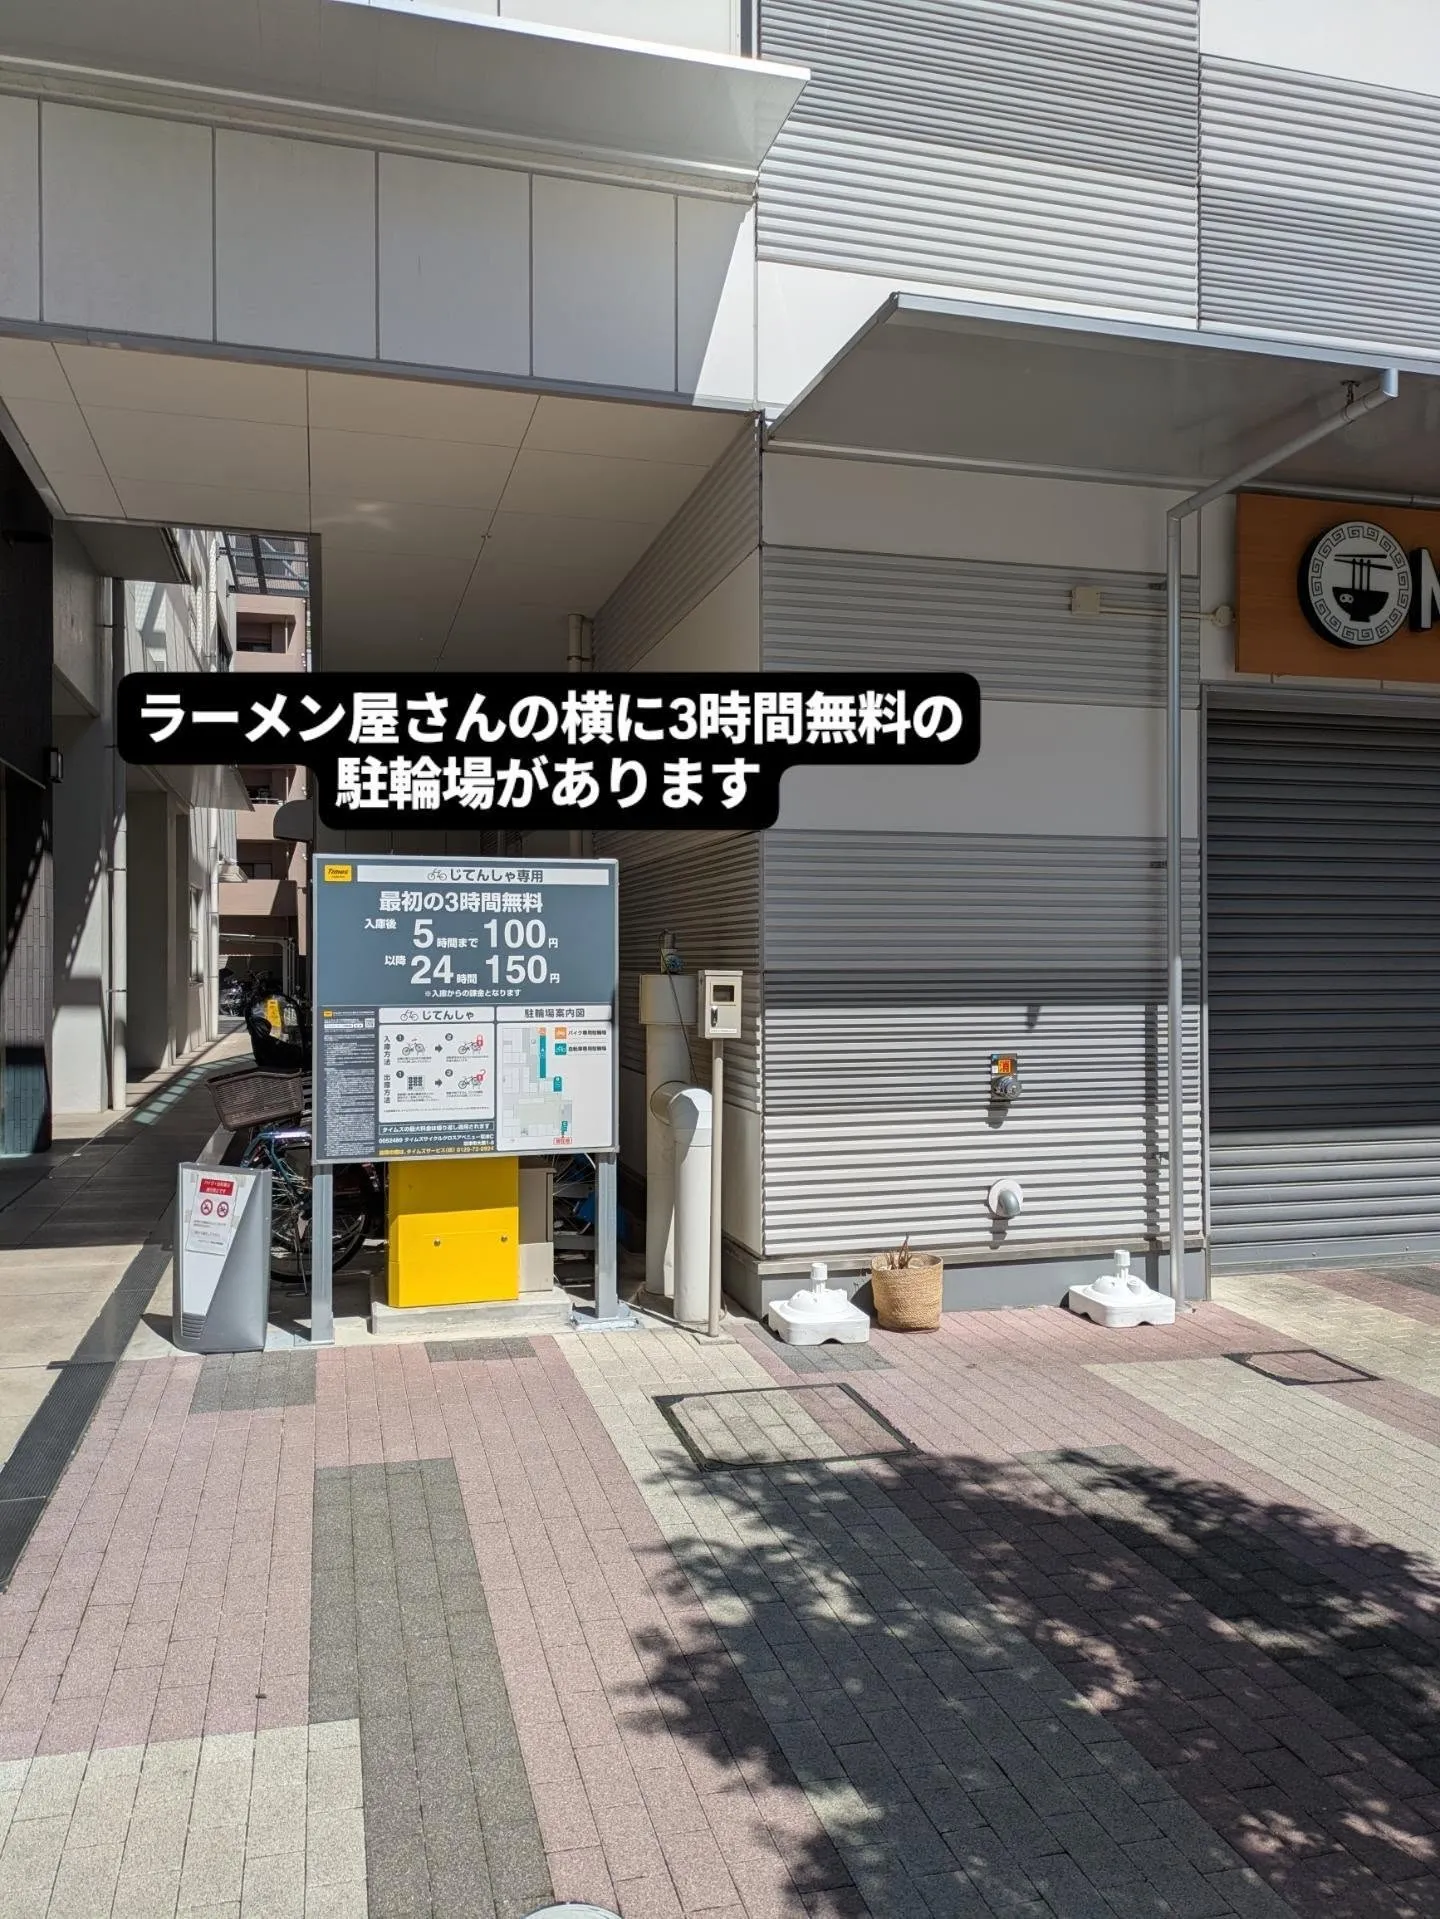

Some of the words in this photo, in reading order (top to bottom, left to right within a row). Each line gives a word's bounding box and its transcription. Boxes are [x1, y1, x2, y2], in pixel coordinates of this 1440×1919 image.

[450, 868, 544, 883] じてんしゃ専用
[379, 890, 544, 913] 最初の3時間無料
[364, 918, 397, 930] 入庫後
[384, 955, 407, 966] 以降
[422, 1010, 475, 1021] じてんしゃ
[524, 1008, 586, 1019] 駐輪場案内図
